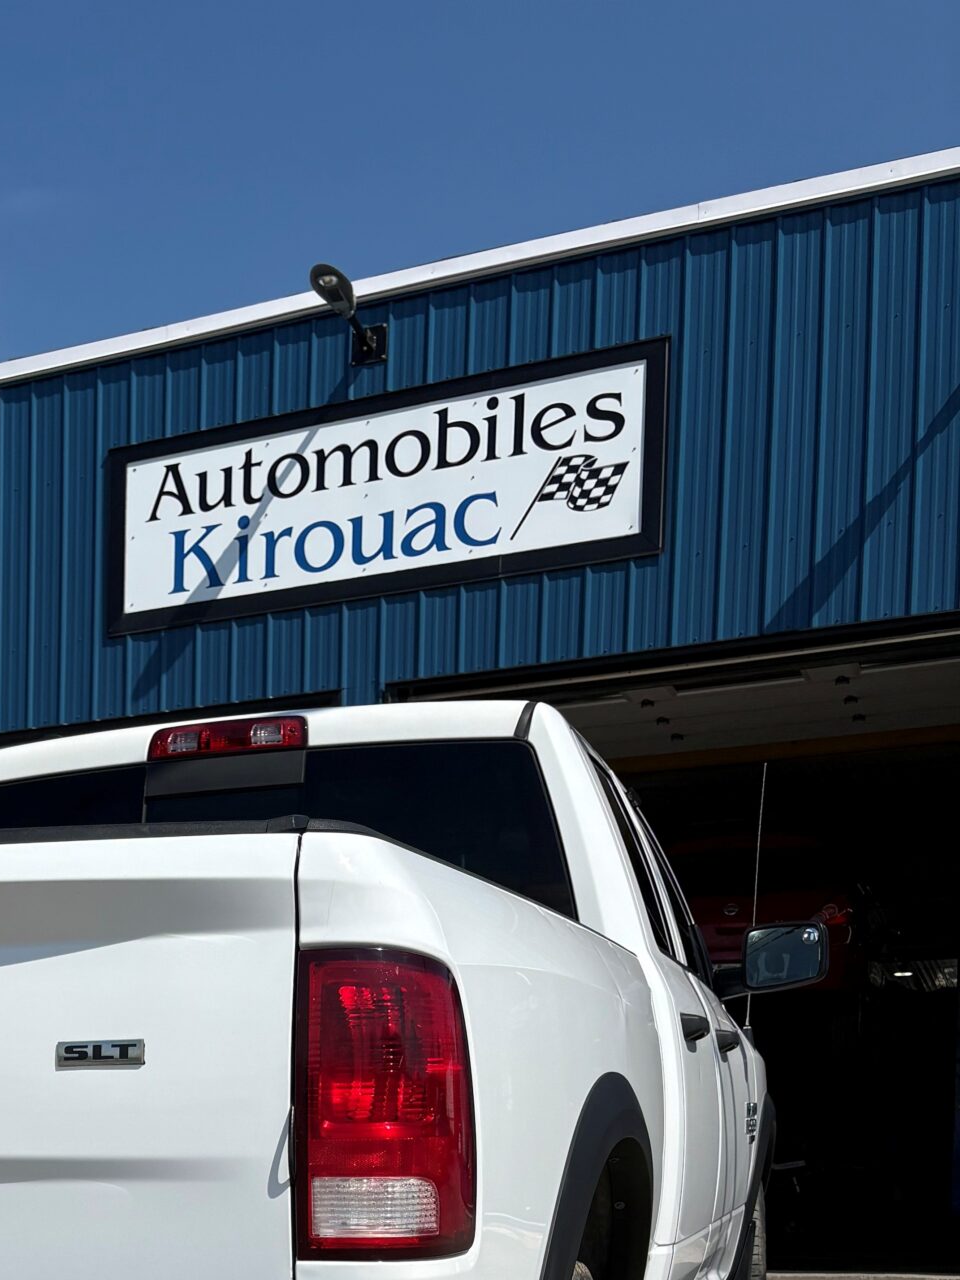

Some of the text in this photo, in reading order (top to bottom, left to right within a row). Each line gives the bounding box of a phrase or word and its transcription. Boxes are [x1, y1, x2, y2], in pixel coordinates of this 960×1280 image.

[146, 392, 626, 523] Automobiles
[168, 491, 502, 595] Kirouac
[63, 1043, 137, 1061] SLT
